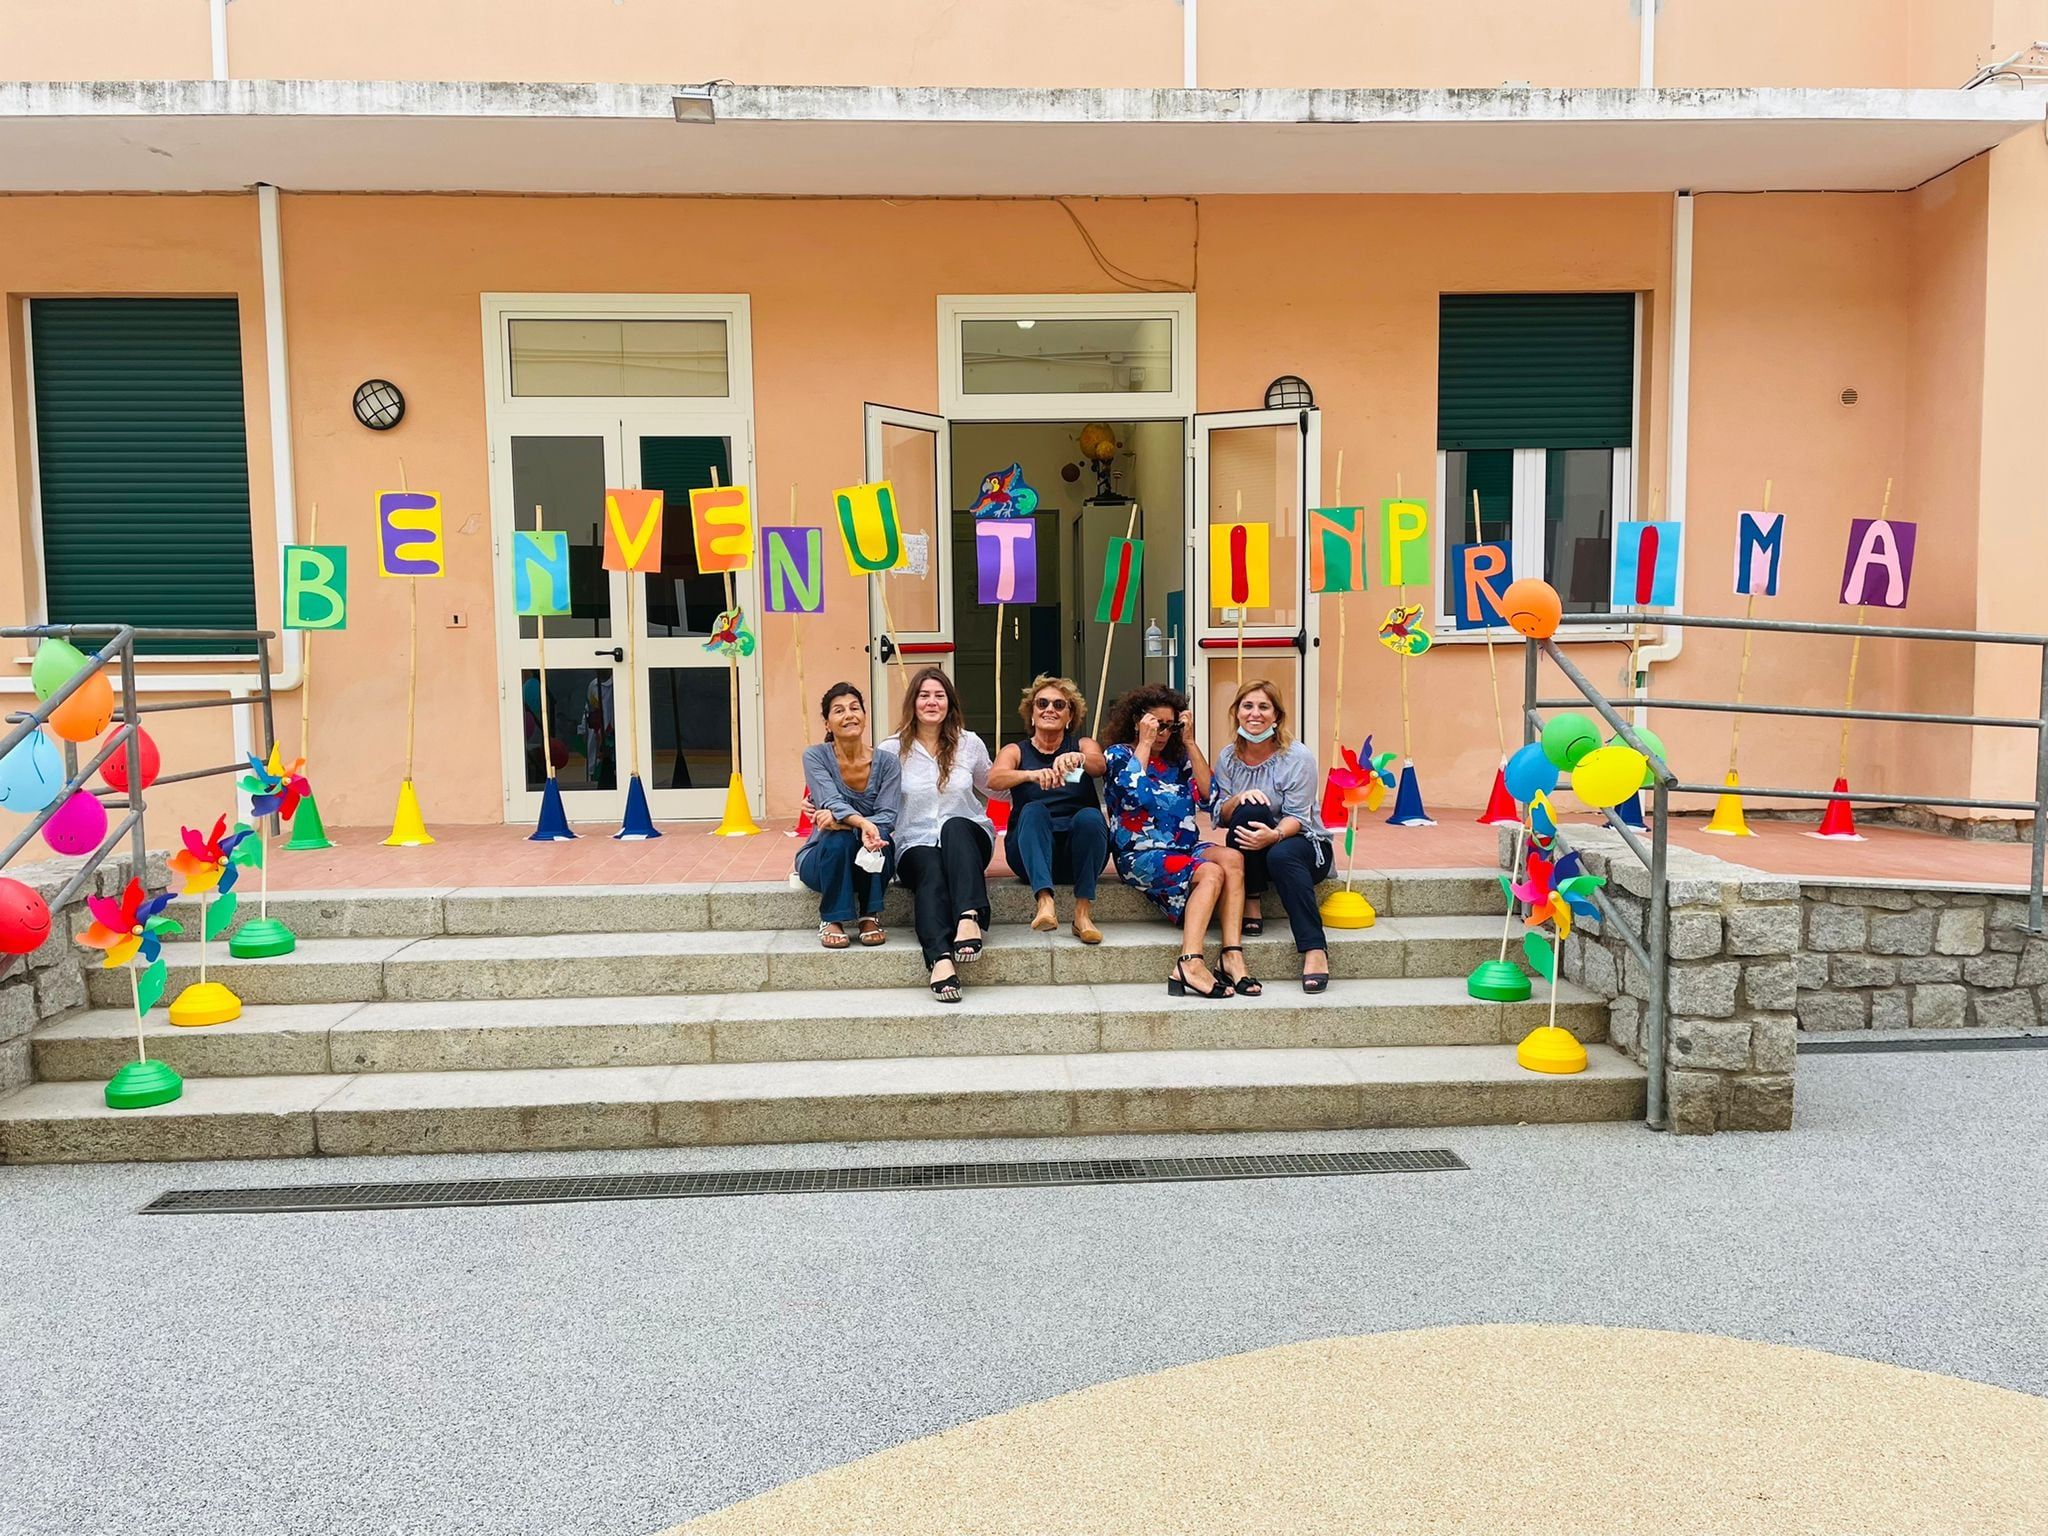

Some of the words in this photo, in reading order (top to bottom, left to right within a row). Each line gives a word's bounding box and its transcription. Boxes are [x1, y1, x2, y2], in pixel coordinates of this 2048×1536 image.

[286, 487, 1133, 628] BENVENUTI
[1230, 508, 1365, 605] IN
[1389, 502, 1905, 622] PRIMA
